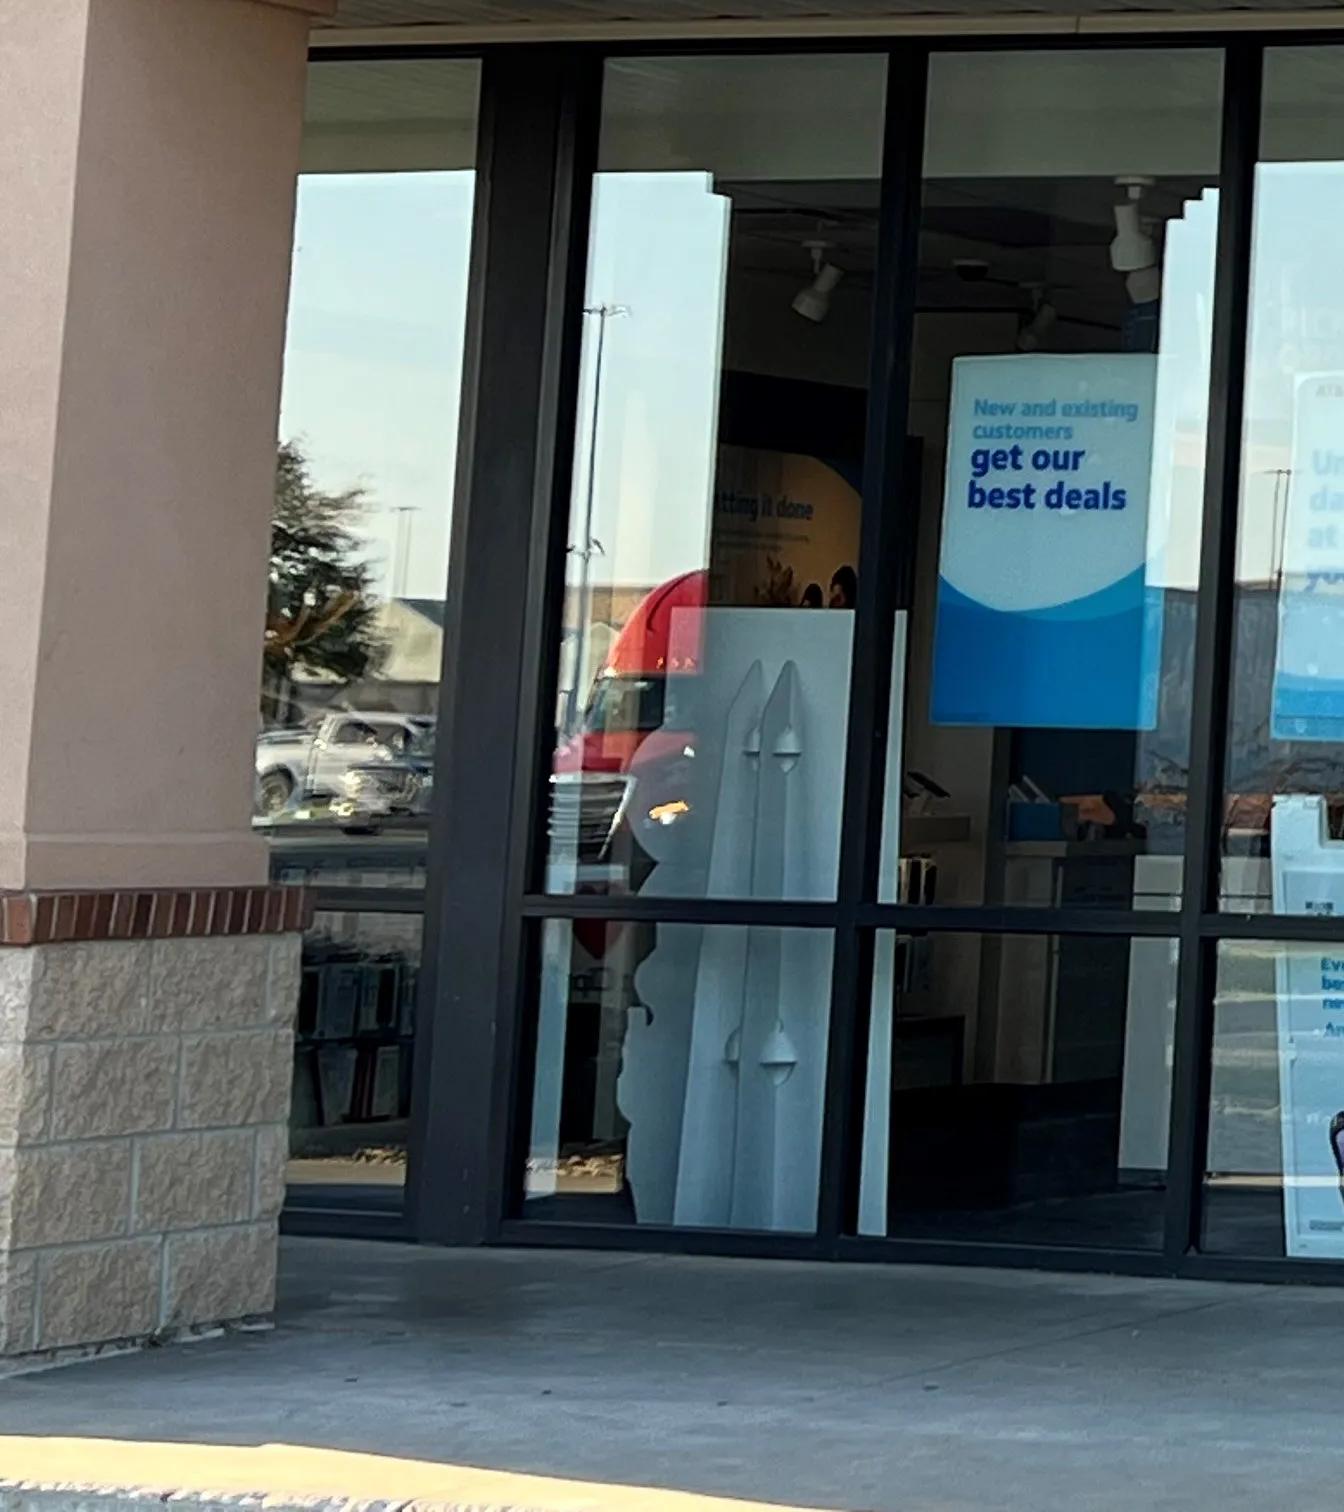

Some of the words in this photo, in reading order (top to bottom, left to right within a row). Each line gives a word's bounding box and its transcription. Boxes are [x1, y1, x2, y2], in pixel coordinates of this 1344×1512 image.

[973, 398, 1017, 417] New
[1021, 399, 1057, 417] and
[1061, 399, 1138, 422] existing
[972, 424, 1075, 439] customers
[970, 443, 1024, 478] get
[1031, 449, 1086, 471] our
[967, 479, 1037, 509] best
[1044, 480, 1127, 510] deals
[777, 495, 815, 520] done
[1307, 525, 1338, 550] at
